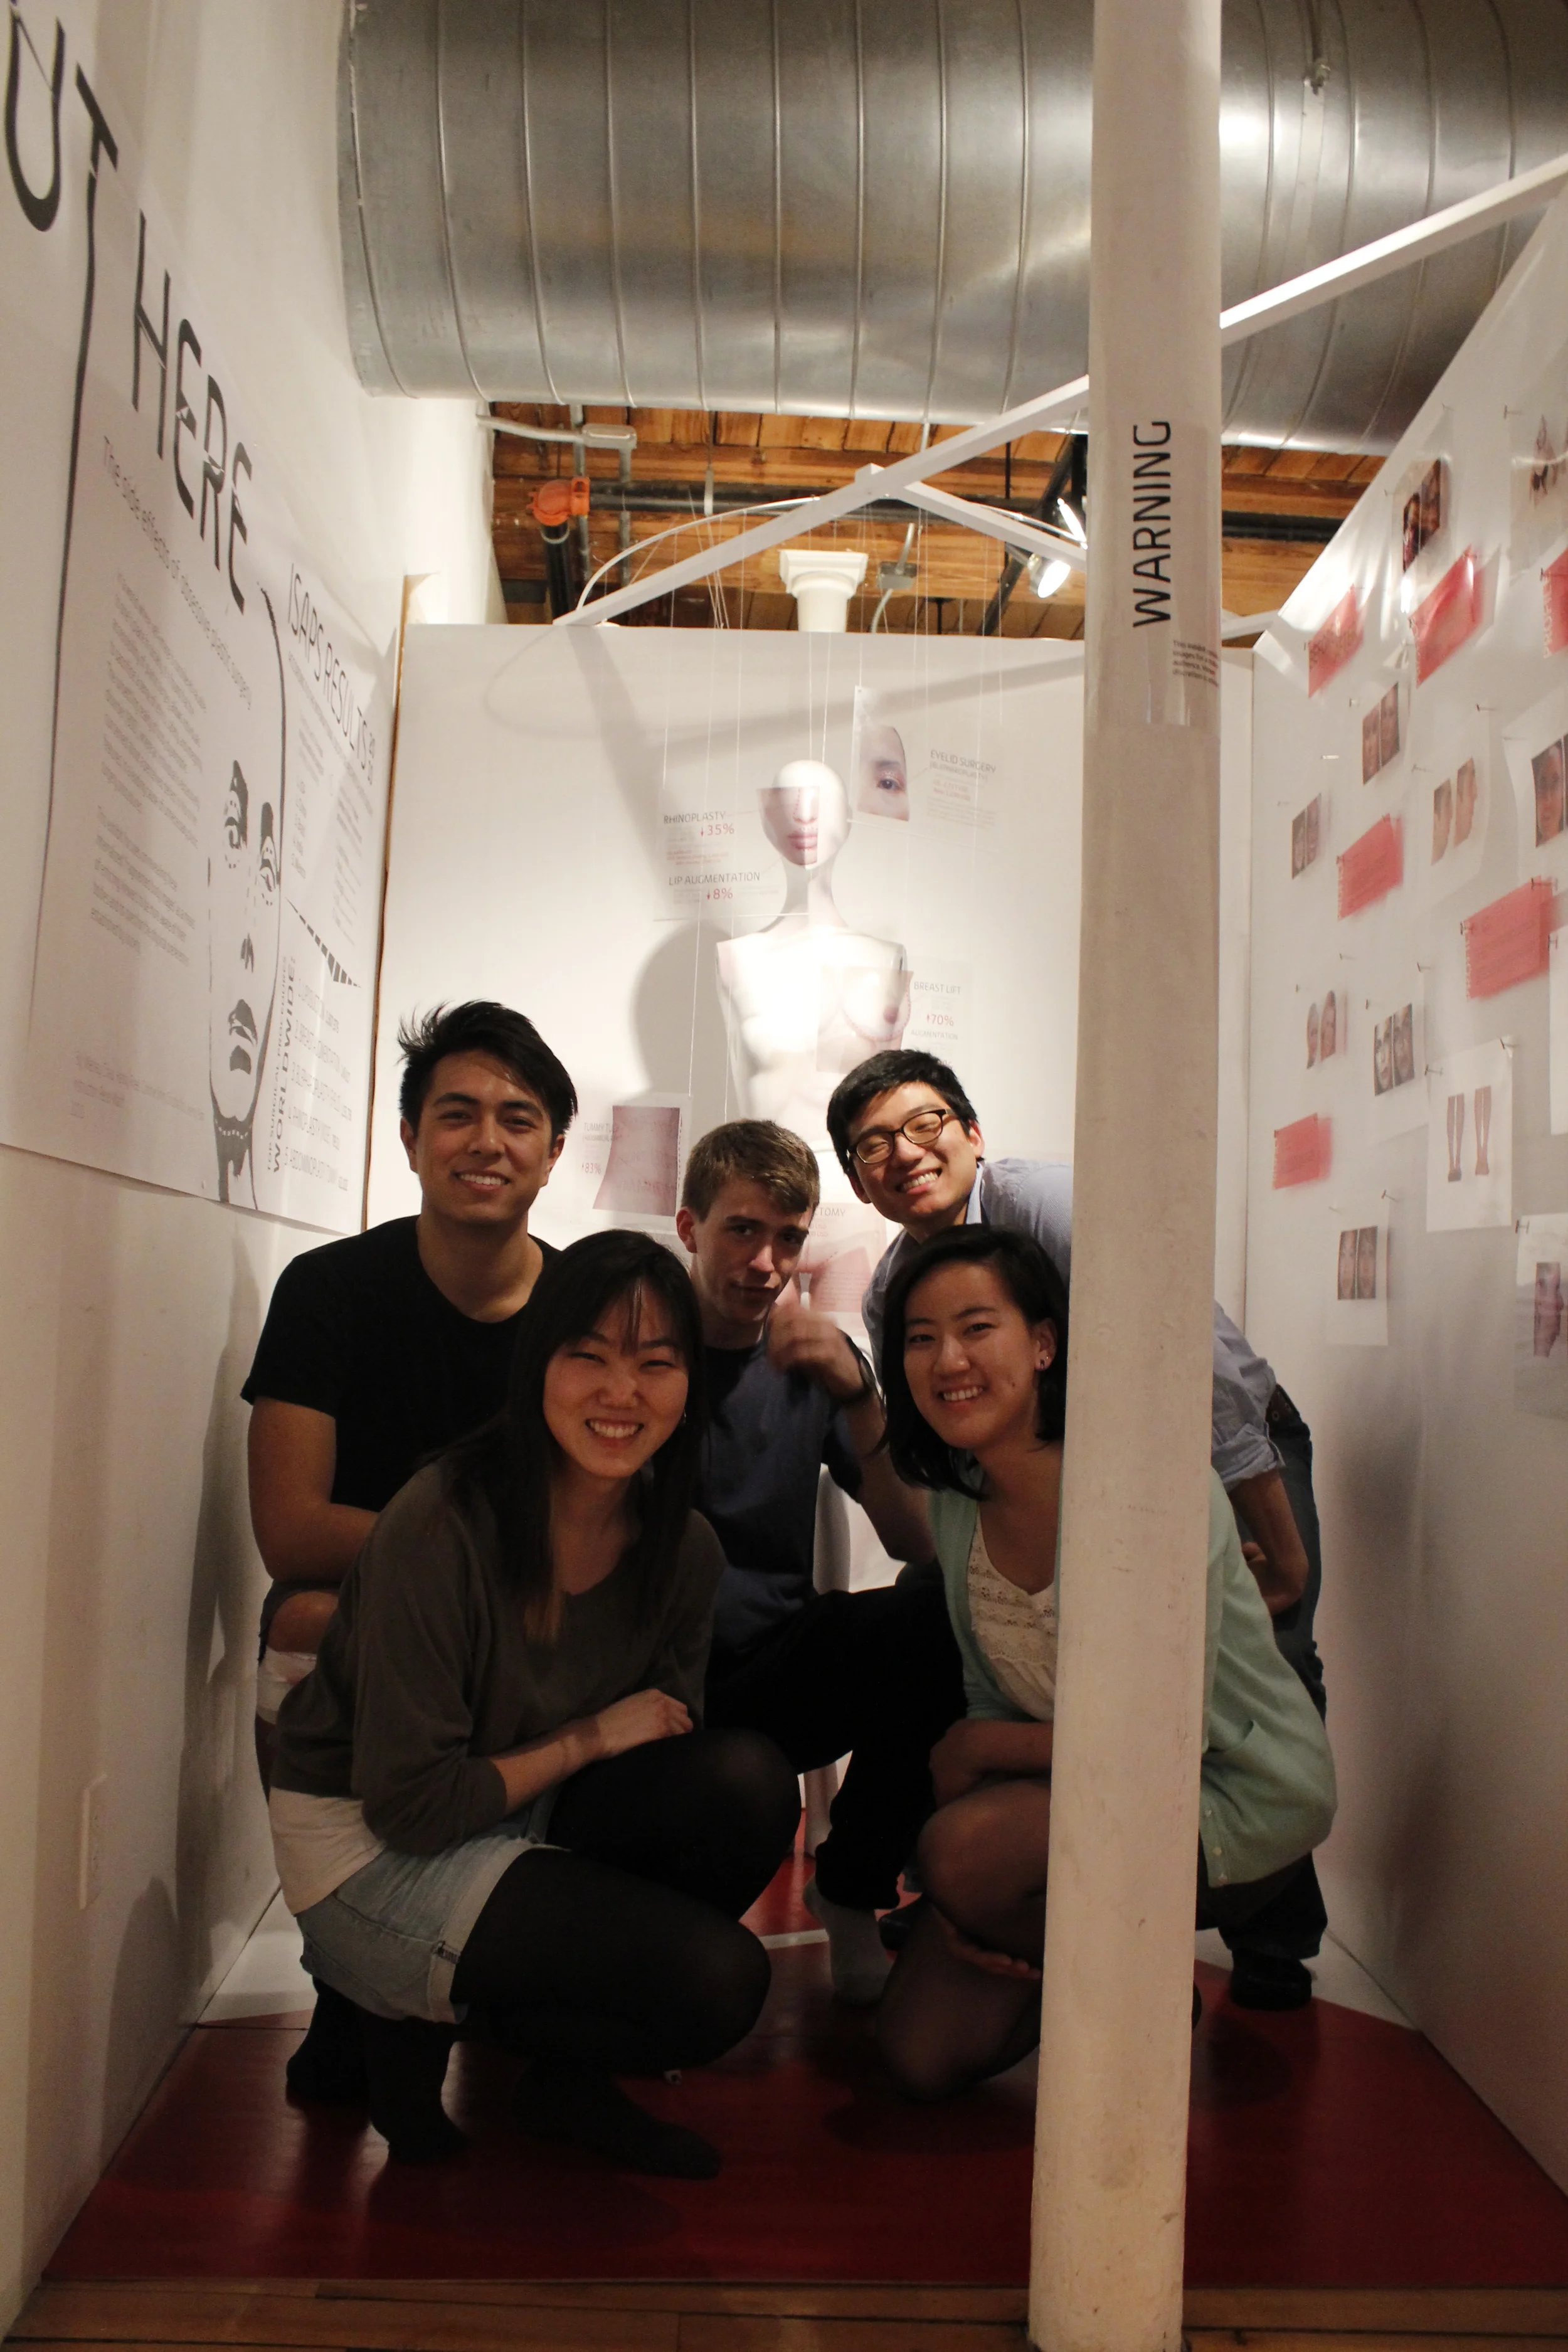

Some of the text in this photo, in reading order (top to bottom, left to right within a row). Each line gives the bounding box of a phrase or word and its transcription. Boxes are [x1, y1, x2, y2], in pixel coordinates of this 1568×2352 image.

[132, 209, 253, 615] HERE
[1132, 420, 1172, 629] WARNING
[288, 563, 324, 682] ISAPS
[323, 642, 368, 771] RESULTS
[930, 750, 996, 773] EYELID SURGERY
[664, 811, 726, 824] RHINOPLASTY
[707, 823, 735, 836] 35%
[669, 872, 760, 886] LIP AUGMENTATION
[713, 887, 733, 899] 8%
[914, 981, 961, 995] BREAST LIFT
[931, 1014, 954, 1027] 70%
[911, 1029, 958, 1041] AUGMENTATION
[274, 956, 295, 1173] WORLDWIDE:
[584, 1122, 605, 1132] TUMMY
[585, 1162, 601, 1174] 83%
